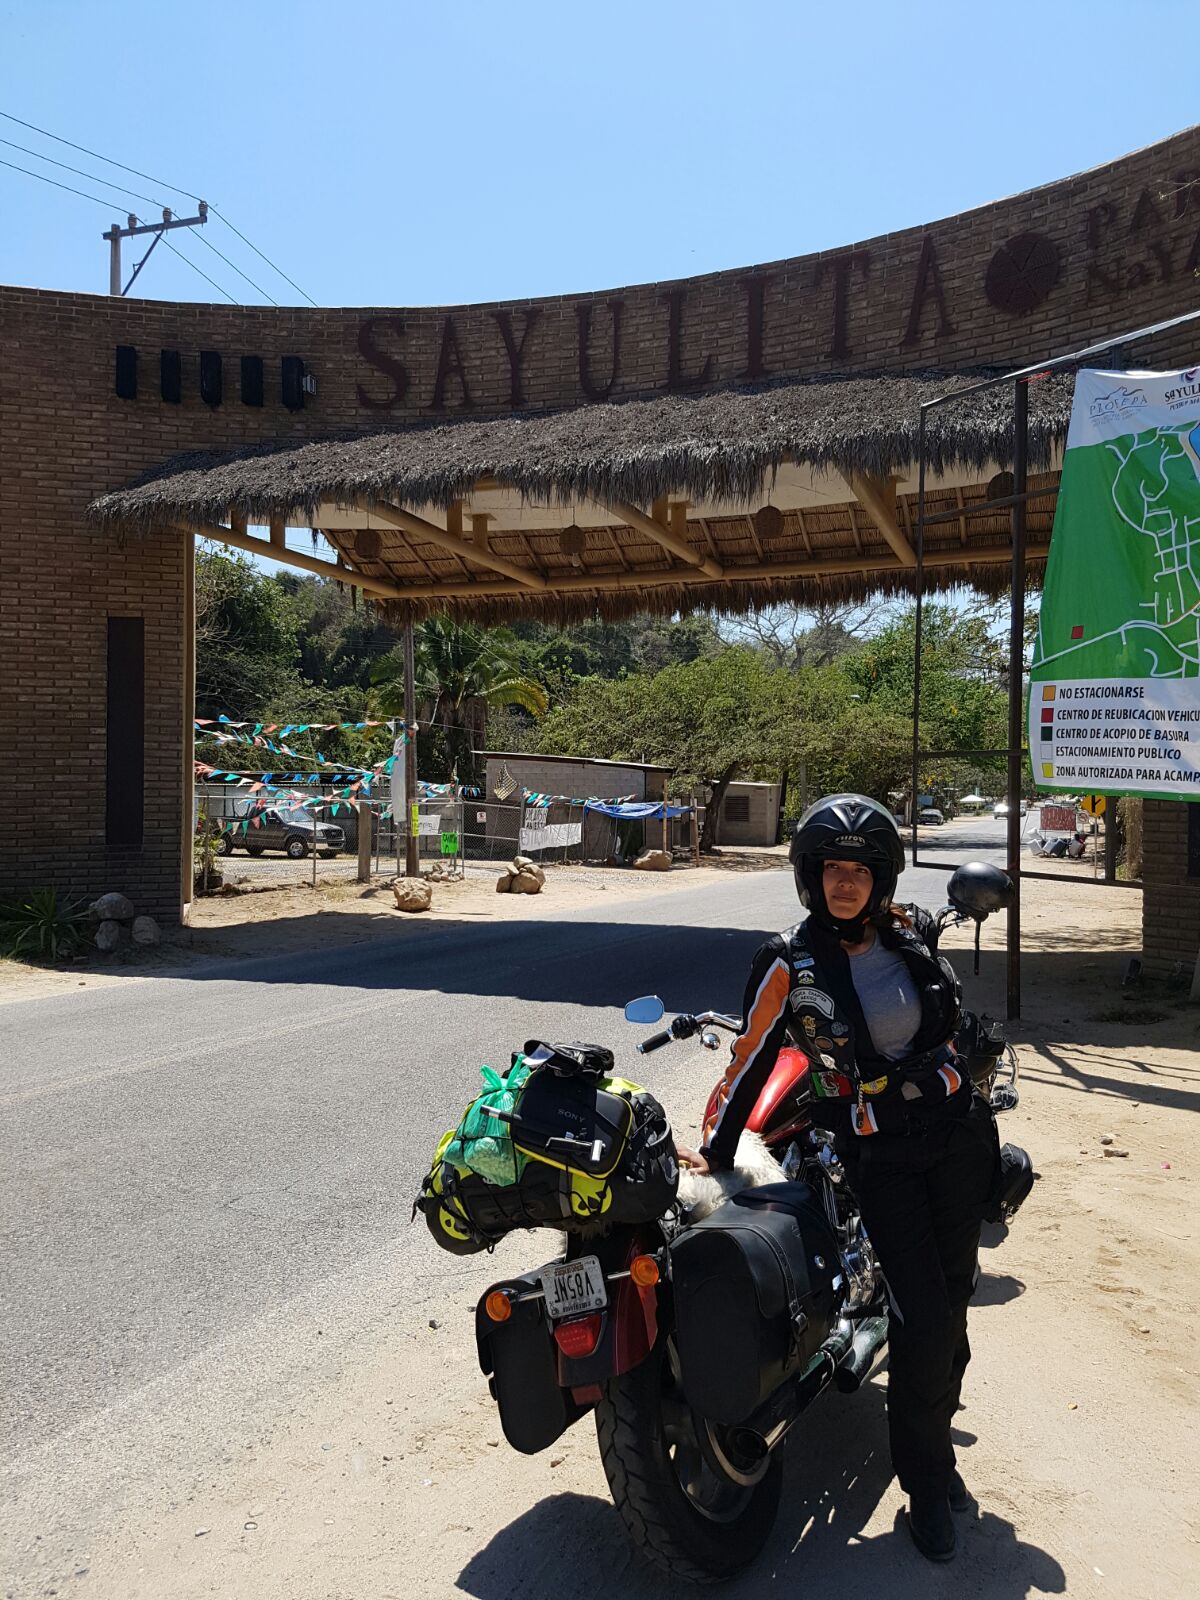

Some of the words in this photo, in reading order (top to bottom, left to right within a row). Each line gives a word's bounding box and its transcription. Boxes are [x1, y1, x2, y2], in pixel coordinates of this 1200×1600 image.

[356, 233, 956, 409] SAYULITA
[1059, 688, 1072, 699] NO
[1074, 687, 1144, 699] ESTACIONARSE
[1057, 709, 1089, 720] CENTRO
[1091, 709, 1102, 720] DE
[1105, 709, 1165, 721] REUBICACION
[1056, 728, 1087, 739] CENTRO
[1090, 728, 1101, 739] DE
[1103, 728, 1137, 739] ACOPIO
[1139, 729, 1151, 739] DE
[1153, 729, 1189, 741] BASURA
[1056, 746, 1135, 758] ESTACIONAMIENTO
[1137, 748, 1181, 760] PUBLICO
[1056, 766, 1076, 777] ZONA
[1078, 767, 1133, 779] AUTORIZADA
[1136, 769, 1161, 781] PARA
[1163, 770, 1200, 783] ACAMP
[557, 1108, 586, 1124] SONY
